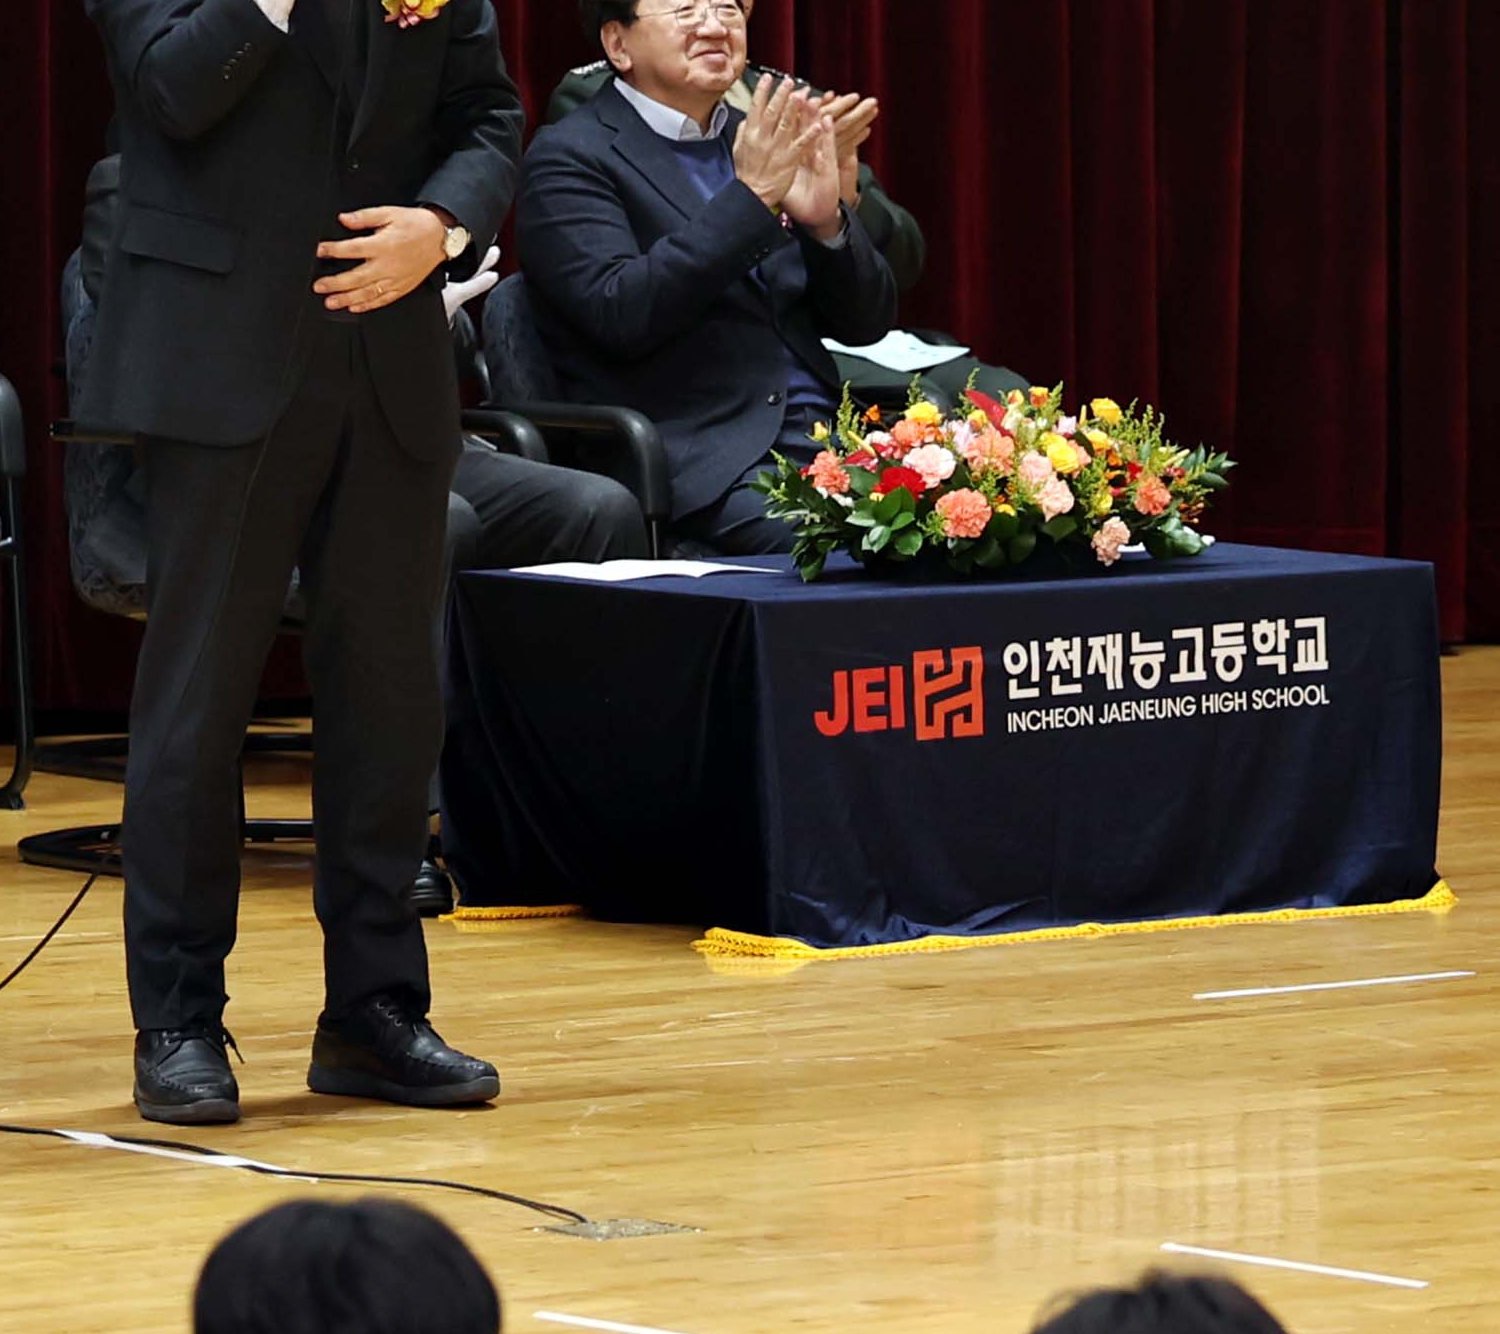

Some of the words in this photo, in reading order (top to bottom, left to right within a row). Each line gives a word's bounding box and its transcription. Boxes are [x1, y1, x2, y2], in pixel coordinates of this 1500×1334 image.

[1002, 616, 1330, 700] 인천재능고등학교
[1006, 704, 1095, 734] INCHEON
[1098, 696, 1197, 724] JAENEUNG
[1201, 689, 1248, 715] HIGH
[1252, 683, 1330, 710] SCHOOL
